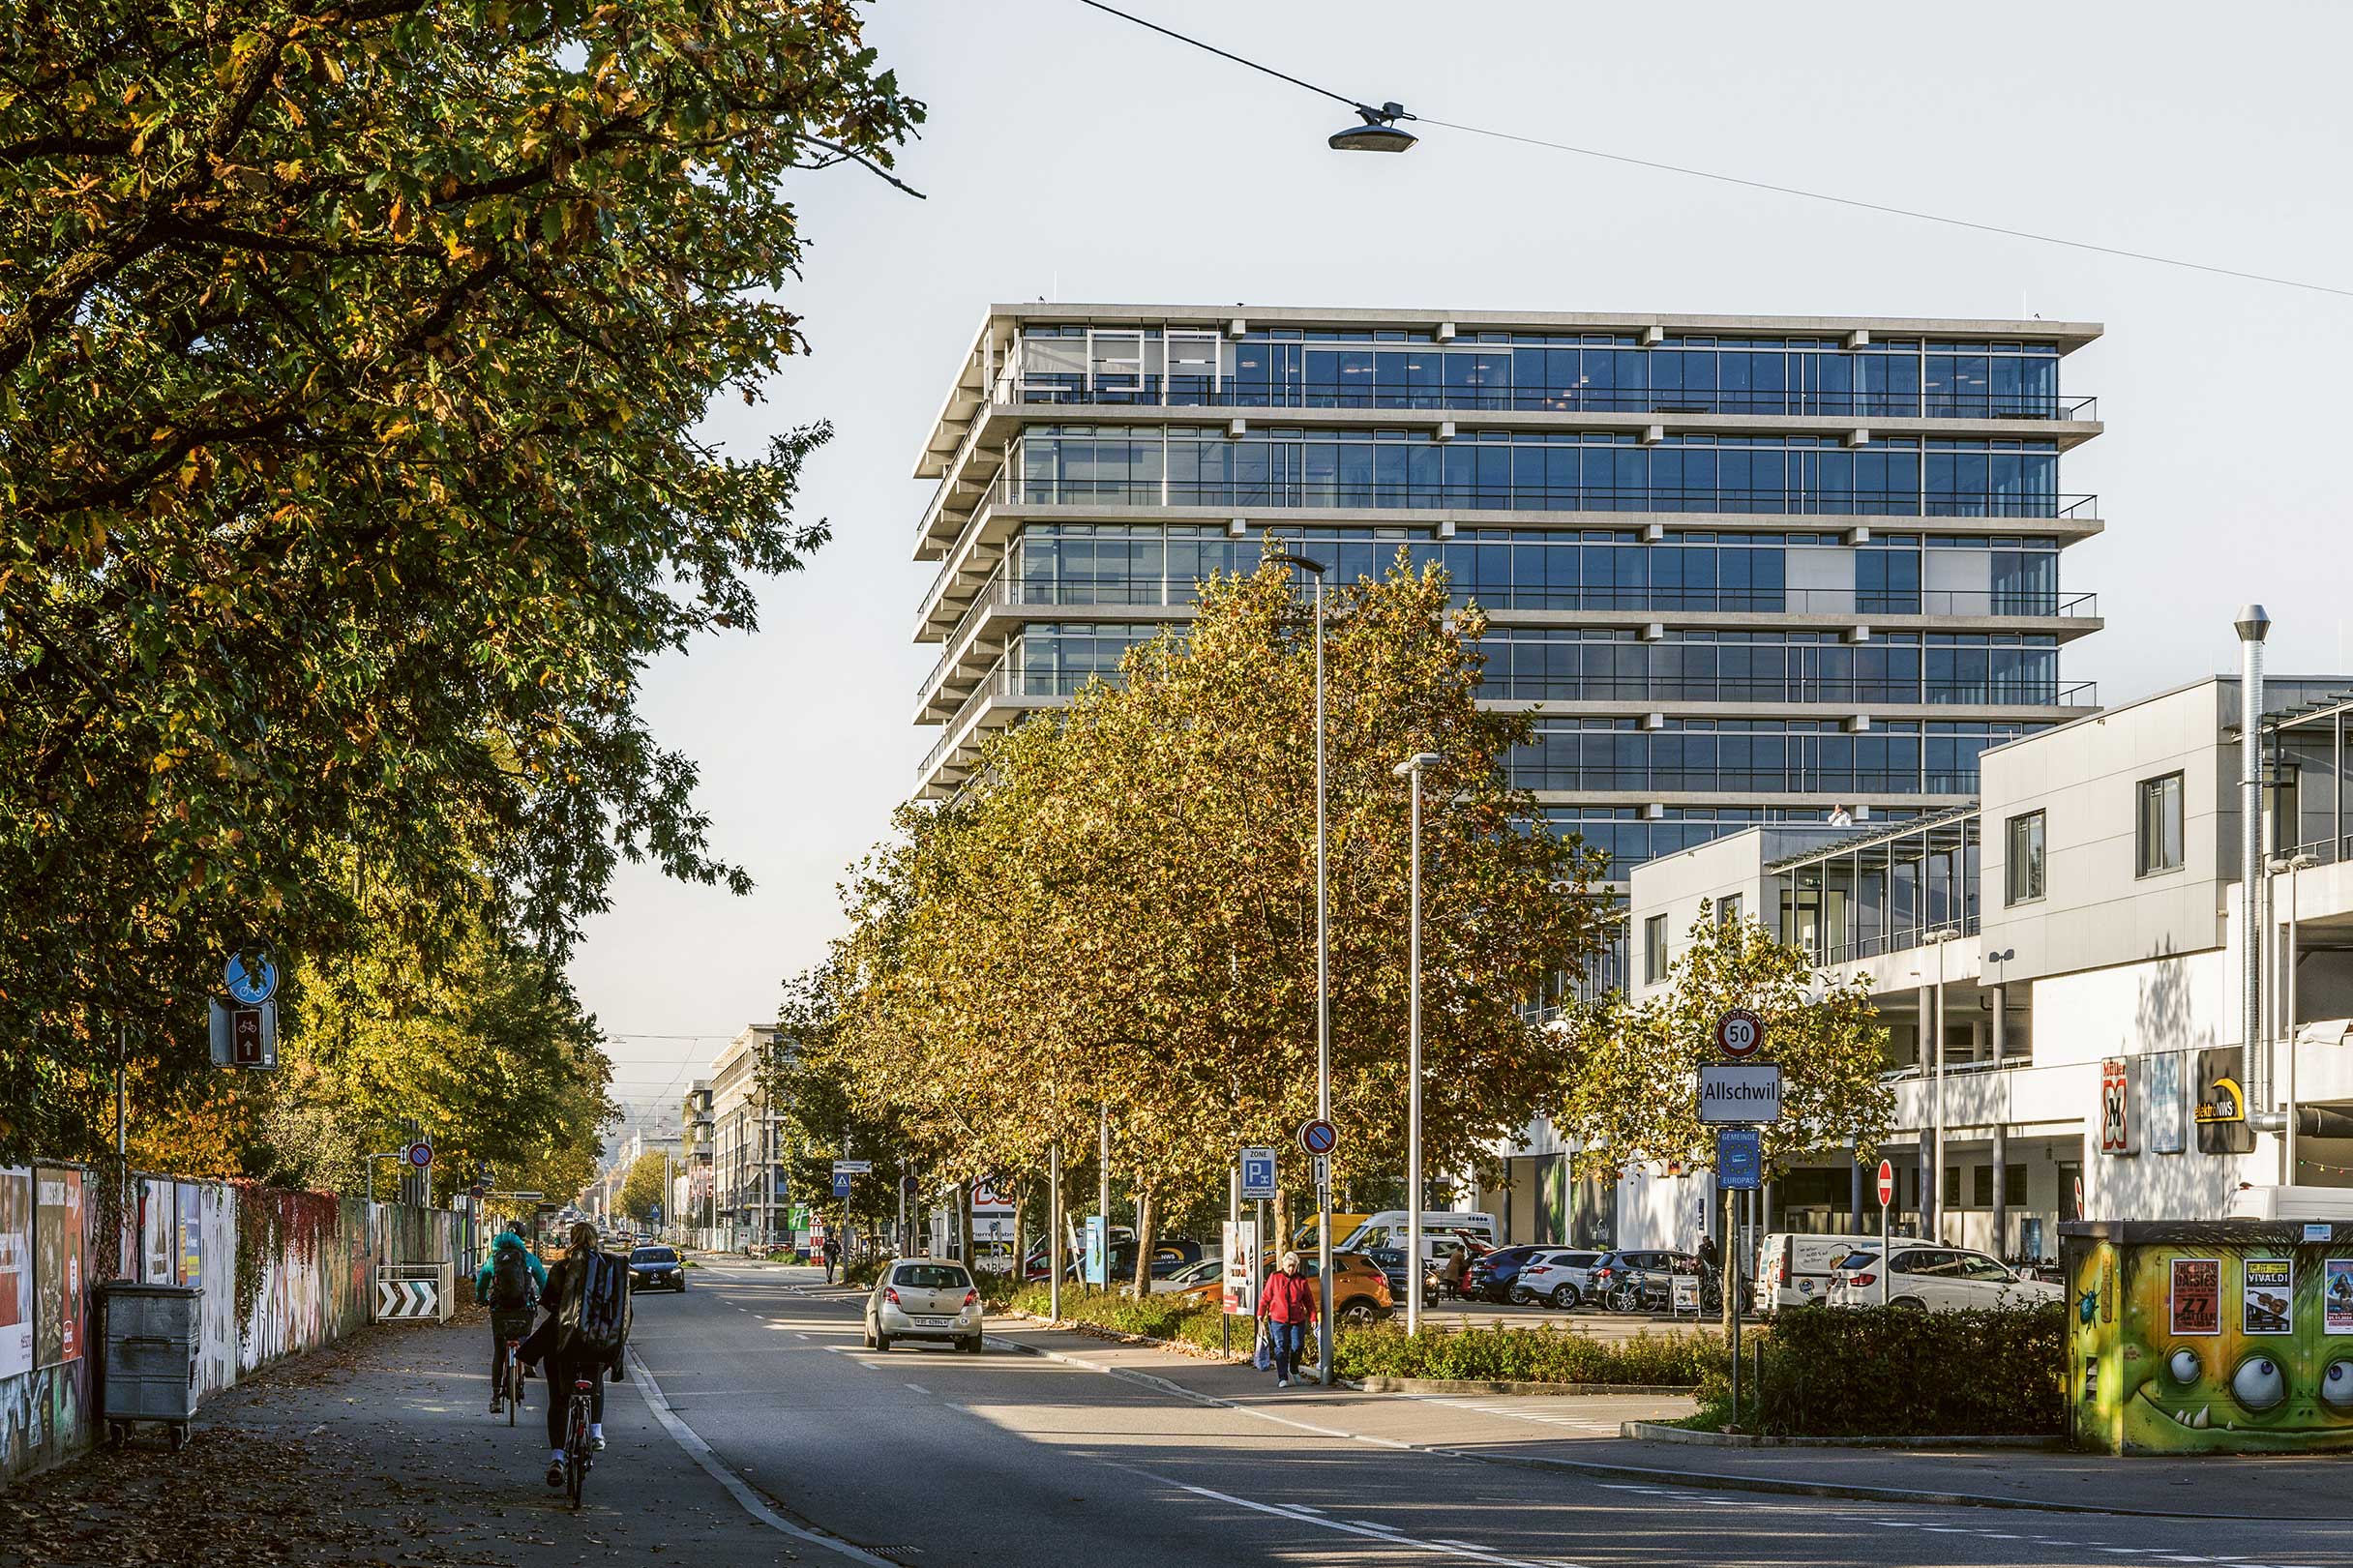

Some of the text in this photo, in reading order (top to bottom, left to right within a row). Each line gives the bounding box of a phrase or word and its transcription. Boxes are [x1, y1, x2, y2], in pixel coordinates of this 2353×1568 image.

[1722, 1011, 1757, 1026] GENERELL
[1729, 1025, 1749, 1043] 50
[2102, 1061, 2126, 1077] Müller
[1705, 1081, 1775, 1100] Allschwil
[2108, 1097, 2121, 1127] M
[2194, 1101, 2233, 1118] elektroNWS
[1721, 1133, 1756, 1141] GEMEINDE
[1249, 1163, 1262, 1183] P
[1722, 1176, 1755, 1185] EUROPAS
[2175, 1275, 2217, 1287] DAISIES
[2249, 1274, 2288, 1283] VIVALDI
[2182, 1298, 2208, 1313] Z7
